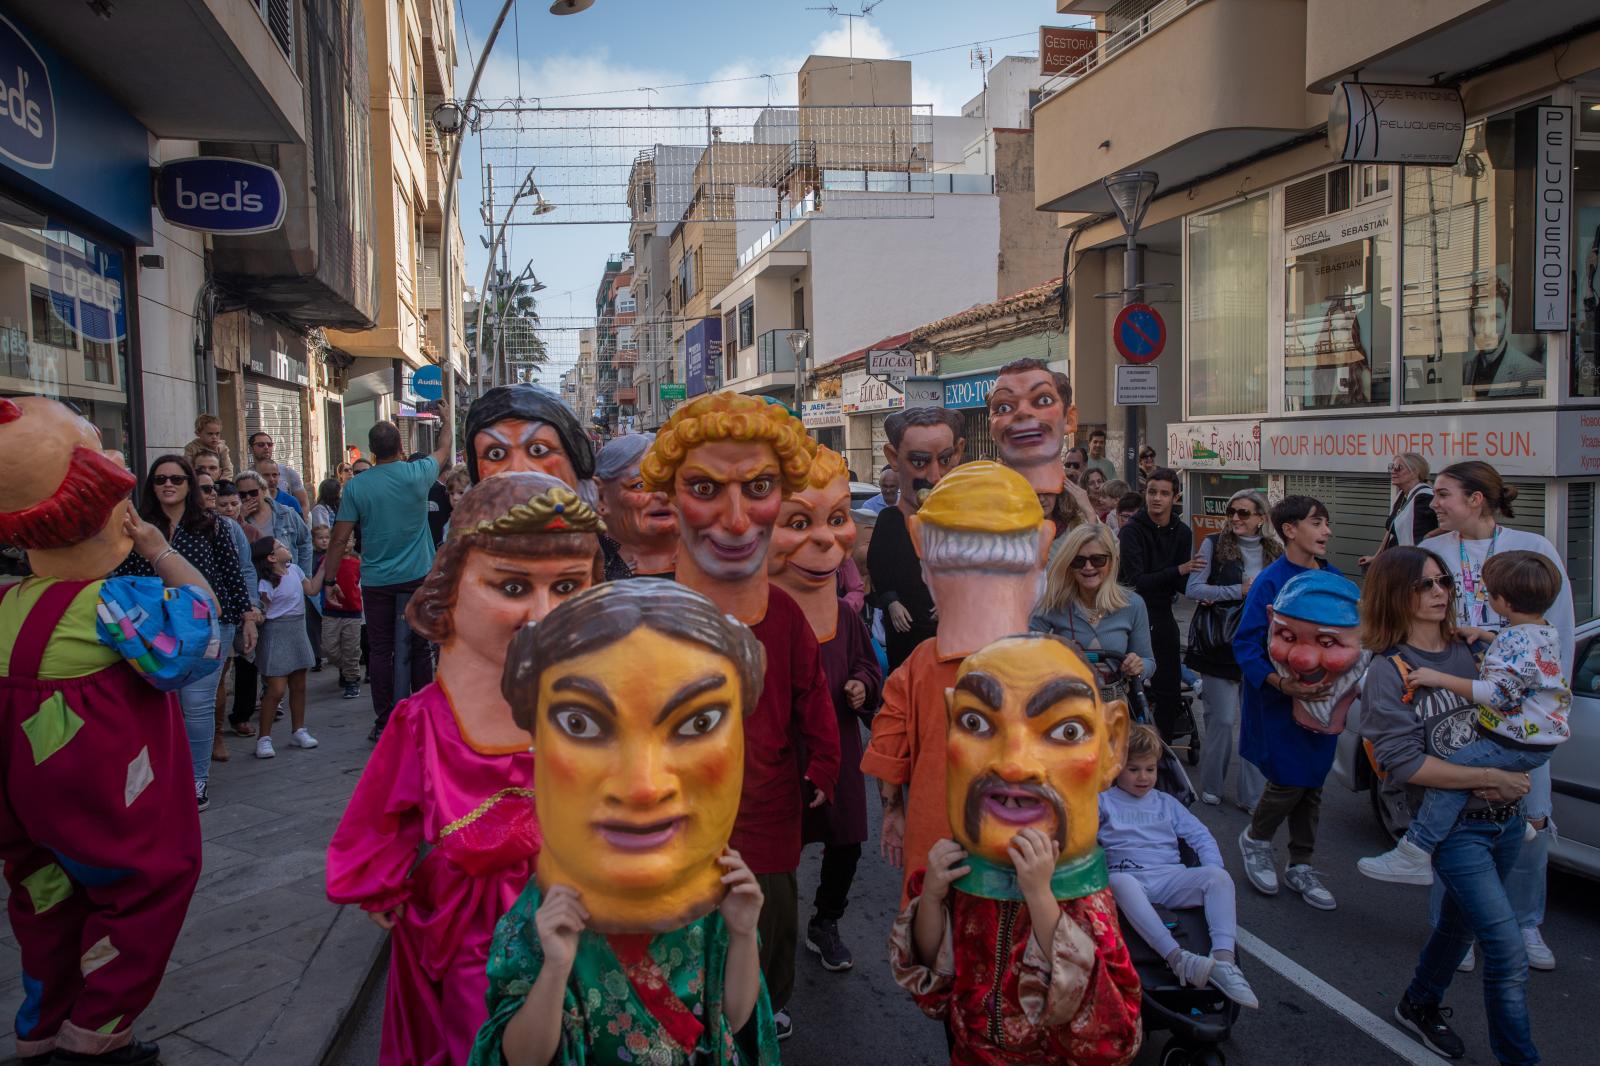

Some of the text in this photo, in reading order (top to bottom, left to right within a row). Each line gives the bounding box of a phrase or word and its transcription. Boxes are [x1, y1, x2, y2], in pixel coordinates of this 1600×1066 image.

[1380, 120, 1461, 131] PELUQUEROS
[176, 177, 264, 213] bed's
[1543, 111, 1564, 297] PELUQUEROS
[1341, 218, 1389, 238] SEBASTIAN
[1315, 259, 1361, 276] SEBASTIAN
[872, 357, 913, 368] ELICASA
[860, 383, 888, 402] ELICASA
[1211, 432, 1261, 461] Fashion
[1270, 431, 1536, 457] YOUR HOUSE UNDER THE SUN.
[1193, 517, 1226, 531] VEN
